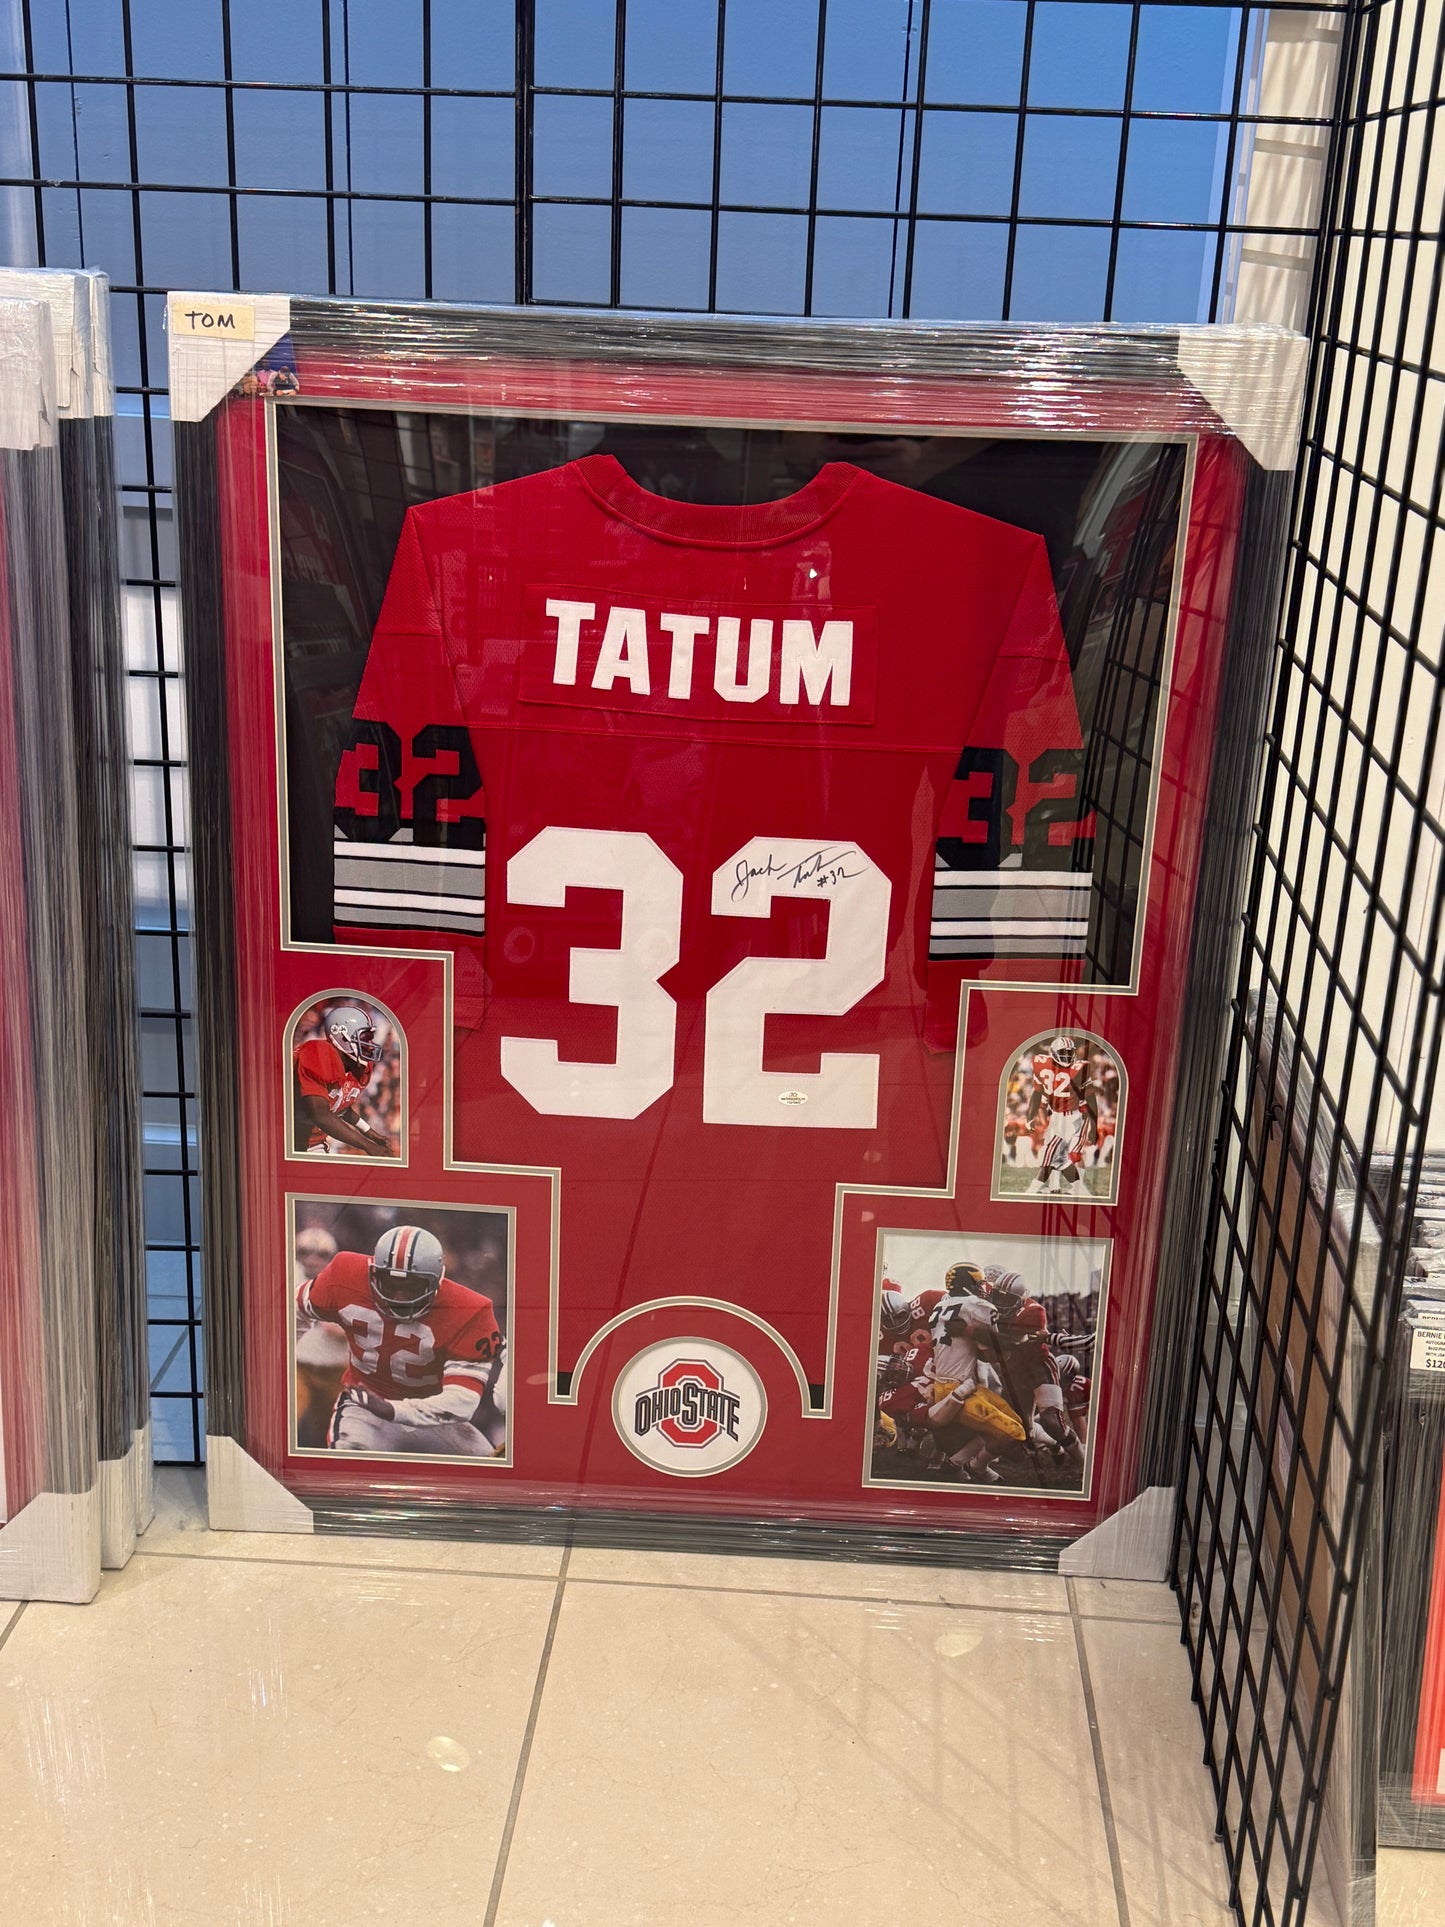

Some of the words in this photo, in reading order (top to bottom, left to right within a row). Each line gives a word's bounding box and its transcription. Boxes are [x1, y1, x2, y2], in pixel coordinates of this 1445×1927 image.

[185, 311, 236, 330] TOM
[546, 598, 854, 706] TATUM
[334, 719, 485, 850] 32
[935, 746, 1096, 871] 32
[500, 826, 893, 1129] 32
[1039, 1068, 1071, 1098] 32
[338, 1303, 440, 1388] 32
